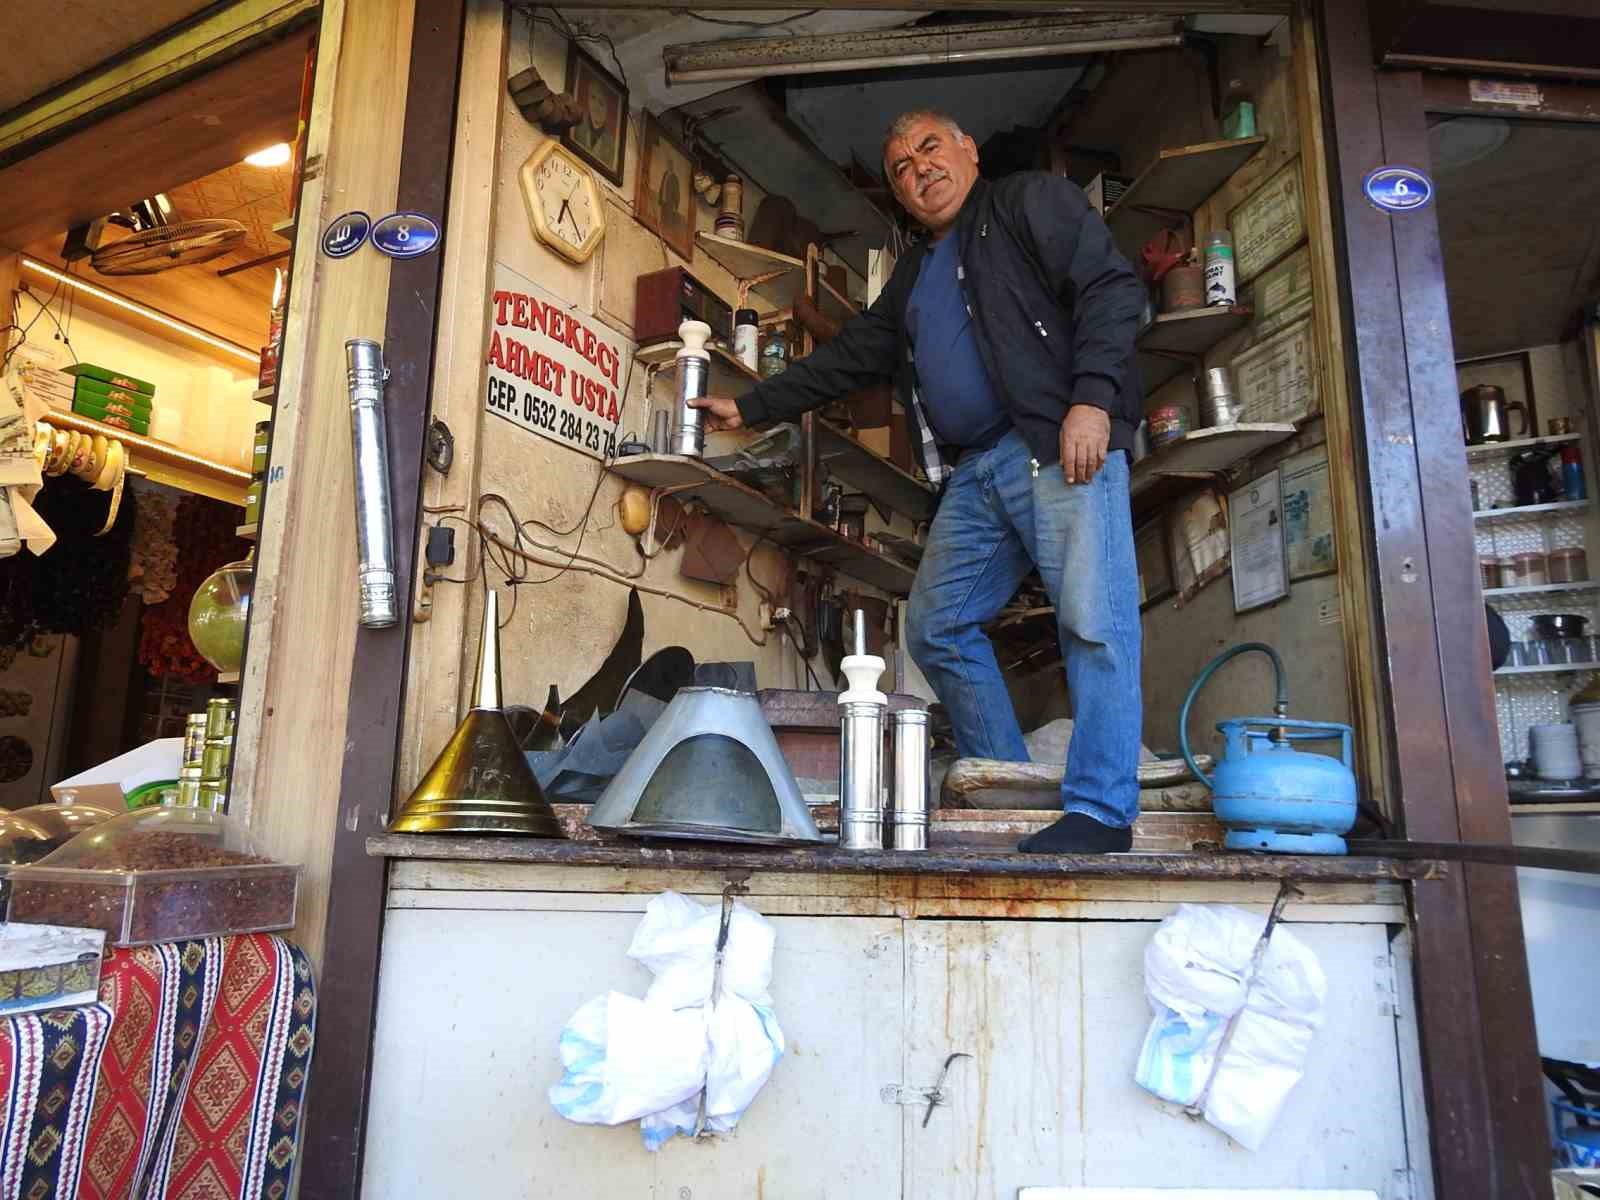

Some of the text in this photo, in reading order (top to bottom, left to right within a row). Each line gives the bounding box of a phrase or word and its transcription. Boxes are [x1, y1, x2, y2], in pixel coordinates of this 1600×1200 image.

[1395, 178, 1409, 196] 6
[397, 223, 411, 242] 8
[487, 330, 620, 425] AHMET USTA
[493, 290, 620, 389] TENEKECİ
[487, 375, 518, 416] CEP.
[523, 392, 557, 433] 0532
[559, 408, 582, 444] 284
[584, 421, 600, 452] 23
